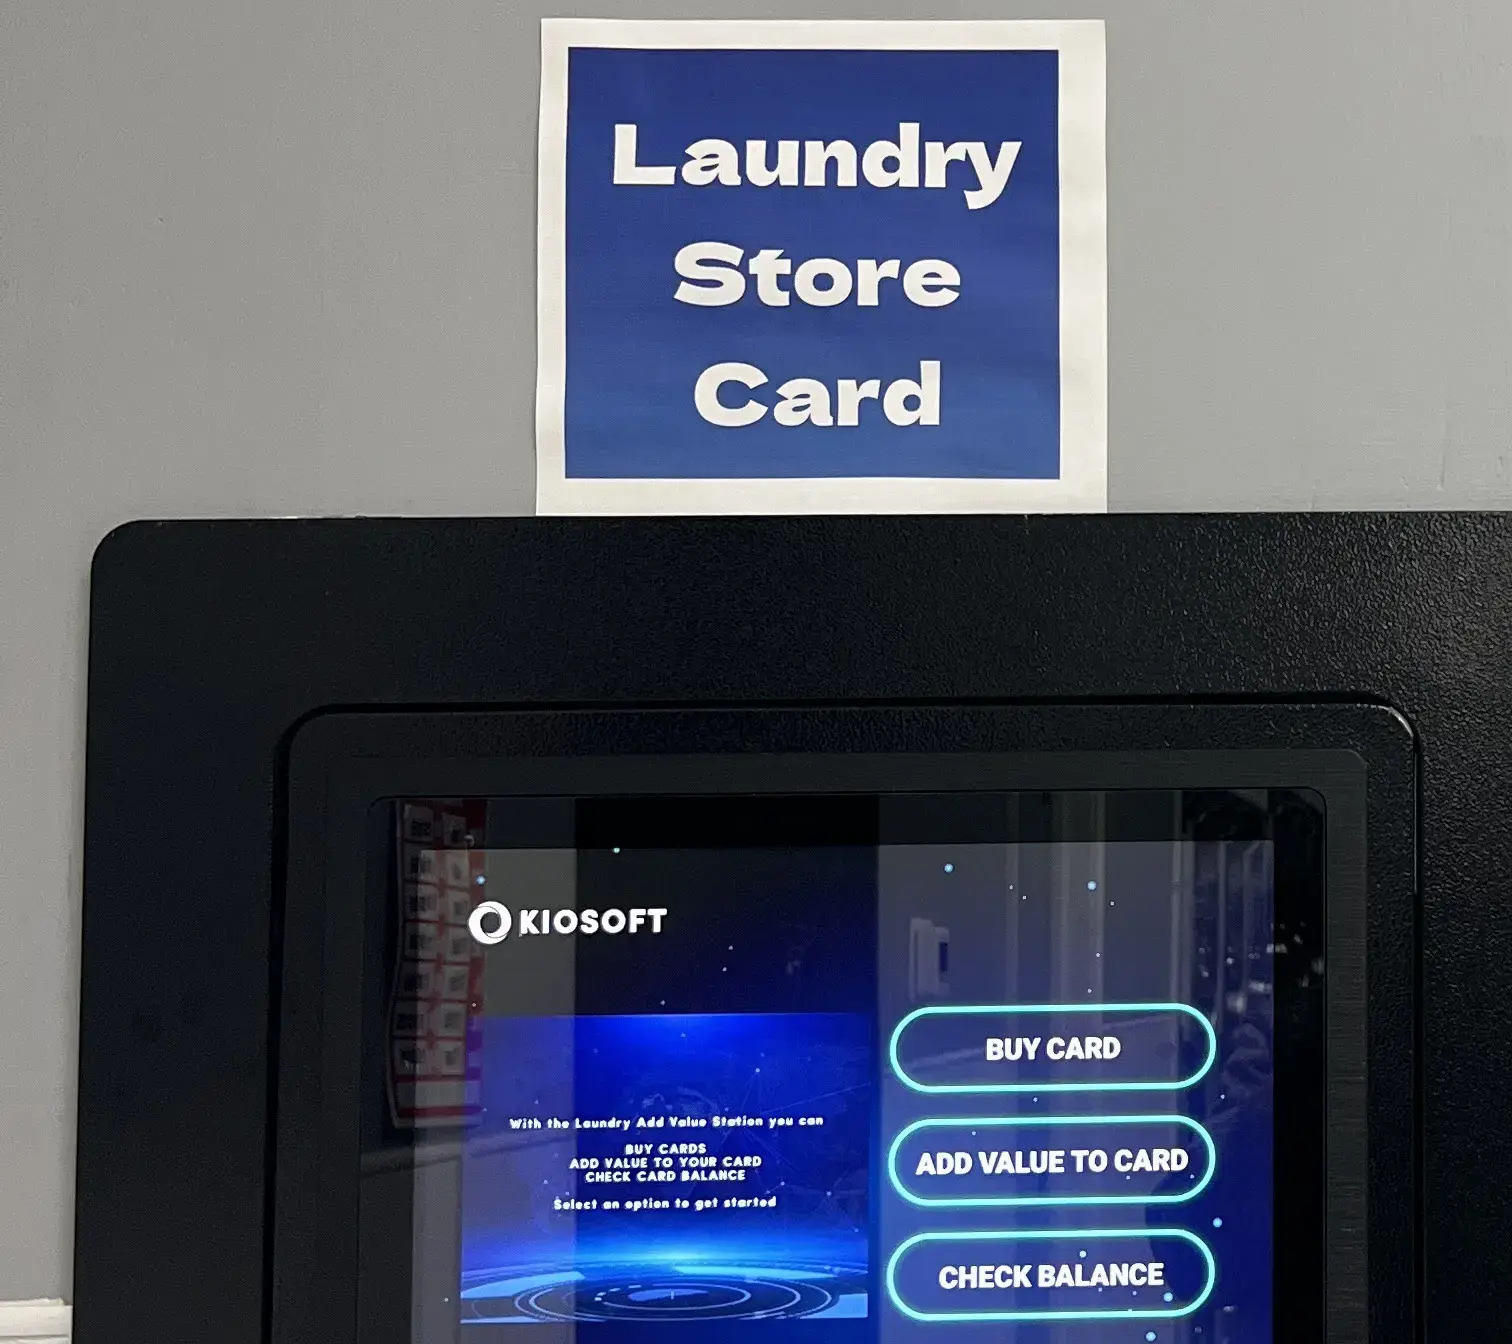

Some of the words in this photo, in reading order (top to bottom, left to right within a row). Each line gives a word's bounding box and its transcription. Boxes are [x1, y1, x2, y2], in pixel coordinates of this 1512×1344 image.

[613, 122, 1022, 210] Laundry
[673, 241, 960, 307] Store
[694, 360, 941, 427] Card
[520, 908, 668, 935] KIOSOFT
[986, 1037, 1041, 1061] BUY
[1046, 1036, 1121, 1060] CARD
[509, 1117, 542, 1129] With
[547, 1117, 569, 1129] the
[575, 1117, 630, 1130] Laundry
[636, 1116, 664, 1128] Add
[669, 1115, 707, 1128] Value
[712, 1115, 763, 1127] Station
[769, 1116, 794, 1129] you
[798, 1116, 824, 1126] can
[625, 1144, 653, 1155] BUY
[659, 1143, 707, 1154] CARDS
[915, 1151, 973, 1175] ADD
[978, 1150, 1065, 1174] VALUE
[1071, 1149, 1108, 1173] TO
[1114, 1148, 1189, 1172] CARD
[569, 1157, 600, 1169] ADD
[605, 1157, 648, 1169] VALUE
[653, 1157, 674, 1168] TO
[679, 1156, 717, 1168] YOUR
[723, 1156, 762, 1167] CARD
[585, 1171, 631, 1182] CHECK
[636, 1170, 676, 1182] CARD
[682, 1169, 746, 1181] BALANCE
[554, 1199, 598, 1211] Select
[603, 1201, 620, 1210] an
[625, 1199, 670, 1212] option
[675, 1199, 690, 1209] to
[695, 1198, 718, 1211] get
[723, 1196, 777, 1207] started
[939, 1265, 1033, 1289] CHECK
[1038, 1263, 1164, 1288] BALANCE
